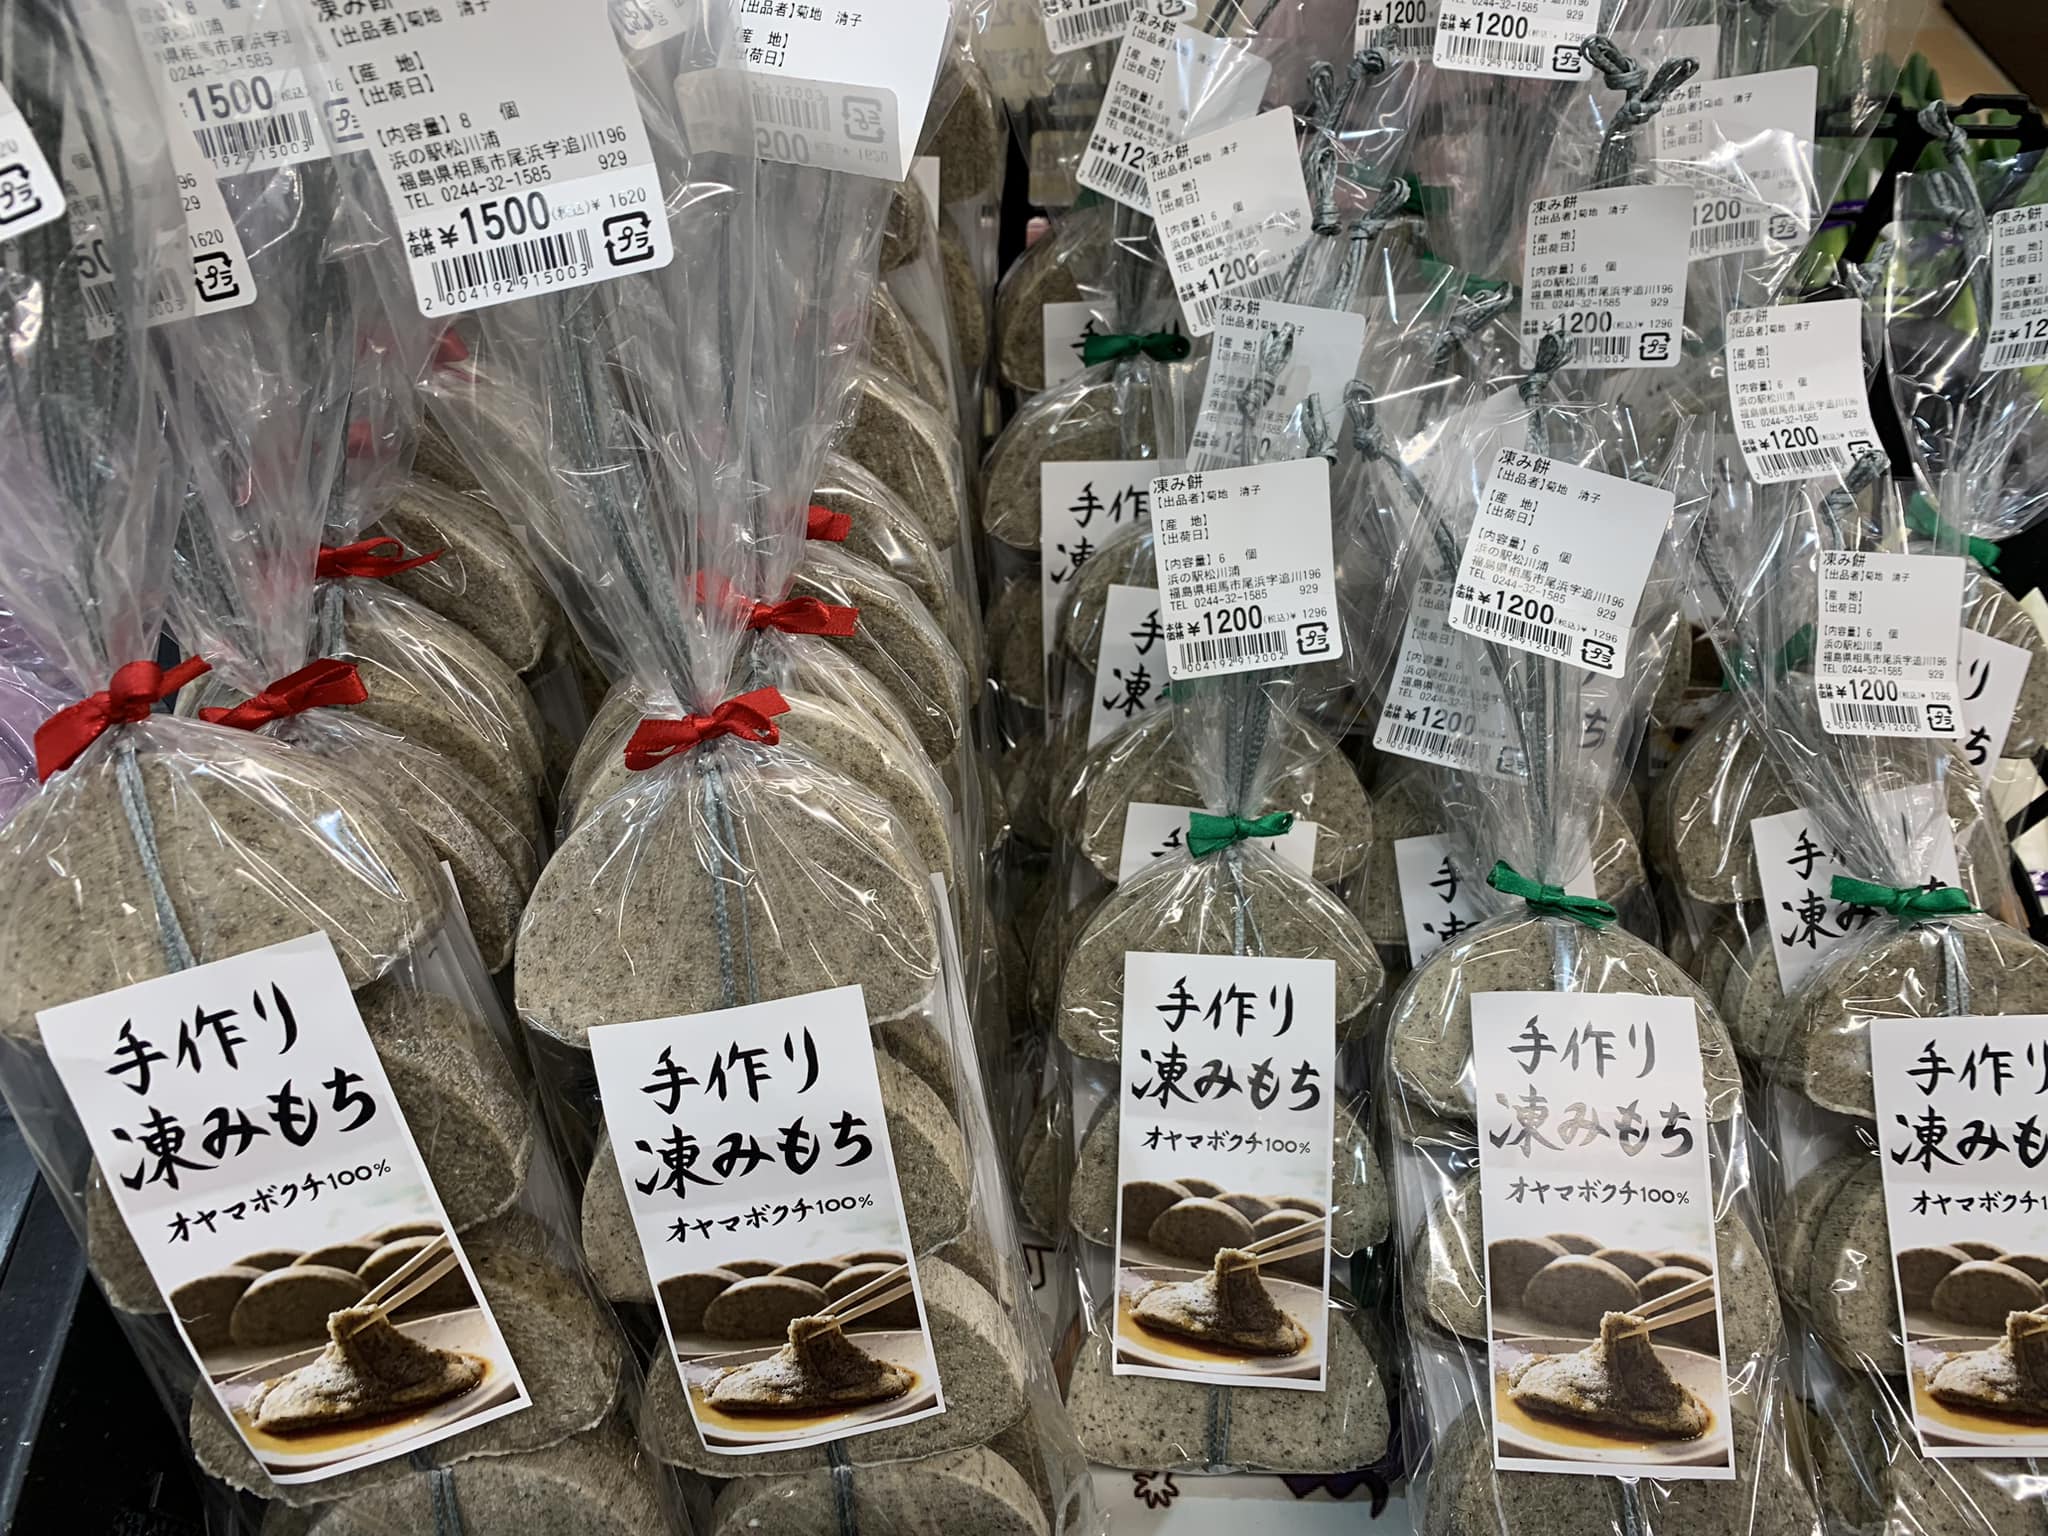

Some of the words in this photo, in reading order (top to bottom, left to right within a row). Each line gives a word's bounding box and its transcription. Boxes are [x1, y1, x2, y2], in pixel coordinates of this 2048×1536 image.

[1133, 9, 1177, 35] 凍み餅
[363, 76, 436, 107] 【出荷日】
[377, 114, 451, 148] 【内容量】
[460, 112, 471, 129] 8
[500, 101, 520, 121] 個
[390, 131, 501, 171] 浜の駅松川浦
[398, 126, 626, 191] 福島県相馬市尾浜字追川196
[1149, 144, 1189, 170] 凍み餅
[404, 194, 433, 211] TEL
[441, 167, 551, 203] 0244-32-1585
[598, 151, 628, 170] 929
[610, 187, 646, 208] 1620
[1531, 196, 1577, 214] 凍み餅
[1996, 207, 2041, 225] 凍み餅
[191, 228, 224, 249] 1620
[1532, 241, 1576, 256] 【出荷日】
[1178, 263, 1193, 274] TEL
[1531, 264, 1573, 277] 【内容量】
[1581, 264, 1587, 273] 6
[1532, 275, 1598, 289] 浜の駅松川浦
[1219, 297, 1261, 315] 凍み餅
[1531, 301, 1544, 310] TEL
[1552, 299, 1621, 309] 0244-32-1585
[1651, 297, 1669, 307] 929
[1650, 319, 1672, 328] 1296
[1729, 310, 1768, 326] 凍み餅
[1742, 420, 1756, 429] TEL
[1497, 449, 1552, 476] 凍み餅
[1153, 474, 1203, 494] 凍み餅
[1240, 484, 1261, 497] 清子
[1578, 488, 1601, 504] 清子
[1486, 503, 1534, 526] 【出荷日】
[1162, 528, 1209, 545] 【出荷日】
[1478, 527, 1527, 552] 【内容量】
[1532, 544, 1539, 555] 6
[1559, 551, 1572, 564] 個
[1164, 554, 1212, 571] 【内容量】
[1219, 553, 1225, 563] 6
[1245, 548, 1257, 561] 個
[1474, 542, 1549, 573] 浜の駅松川浦
[1823, 552, 1866, 568] 凍み餅
[1167, 565, 1240, 586] 浜の駅松川浦
[1169, 568, 1321, 599] 福島県相馬市尾浜字追川196
[1170, 601, 1188, 611] TEL
[1194, 589, 1268, 608] 0244-32-1585
[1299, 584, 1318, 595] 929
[1469, 567, 1486, 581] TEL
[1492, 574, 1566, 605] 0244-32-1585
[1596, 607, 1616, 621] 929
[1303, 607, 1327, 619] 1296
[1825, 602, 1862, 614] 【出荷日】
[1305, 630, 1327, 647] プラ
[1593, 628, 1618, 644] 1296
[1824, 626, 1861, 638] 【内容量】
[1823, 664, 1837, 673] TEL
[1398, 687, 1413, 698] TEL
[1155, 974, 1295, 1040] 手作り
[105, 981, 299, 1097] 手作り
[1508, 1014, 1656, 1080] 手作り
[638, 1024, 821, 1116] 手作り
[1130, 1041, 1322, 1112] 凍みもち
[111, 1065, 378, 1191] 凍みもち
[1489, 1082, 1695, 1160] 凍みもち
[1140, 1125, 1311, 1156] オヤマボクチ100%
[633, 1110, 874, 1200] 凍みもち
[165, 1158, 393, 1245] オヤマボクチ100%
[1504, 1175, 1691, 1207] オヤマボクチ100%
[664, 1193, 875, 1244] オヤマボクチ100%
